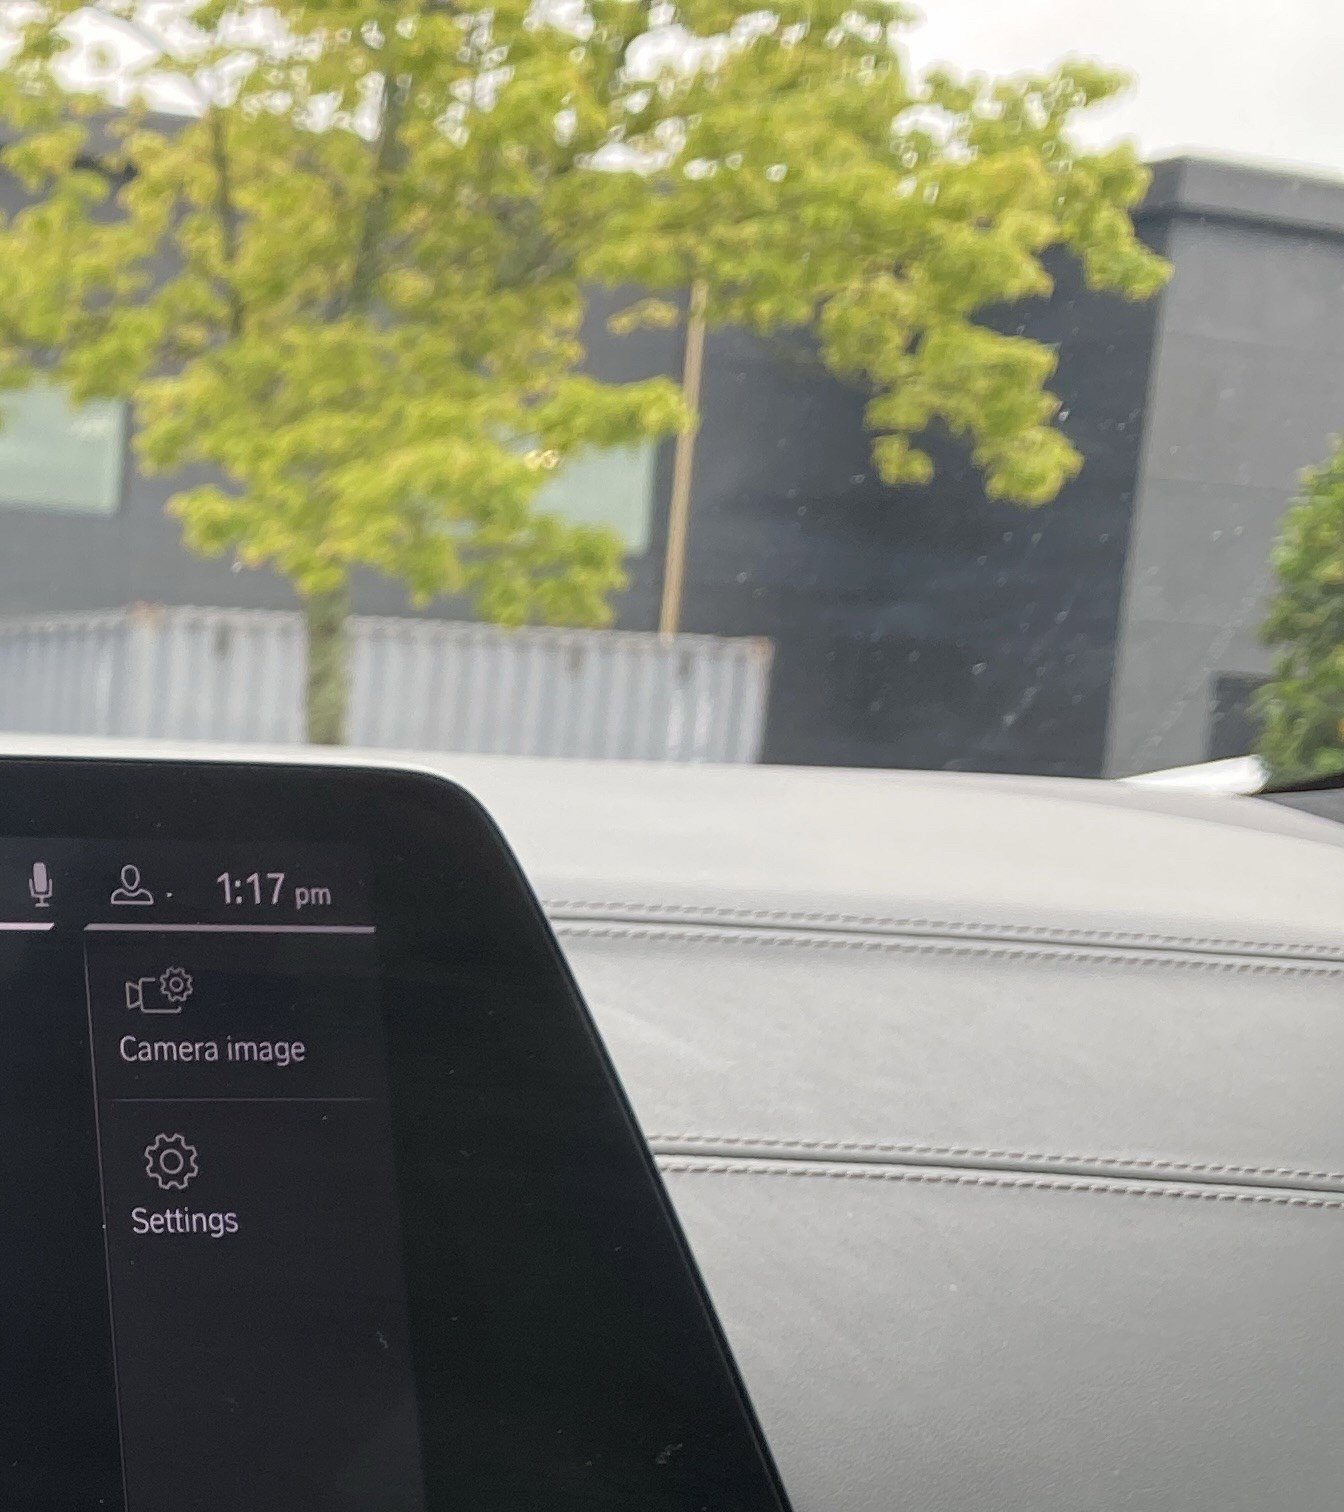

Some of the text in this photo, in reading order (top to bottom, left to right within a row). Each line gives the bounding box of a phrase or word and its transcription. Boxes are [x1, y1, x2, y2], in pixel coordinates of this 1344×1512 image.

[216, 872, 332, 910] 1:17 pm
[120, 1036, 305, 1066] Camera image
[131, 1206, 239, 1238] Settings
